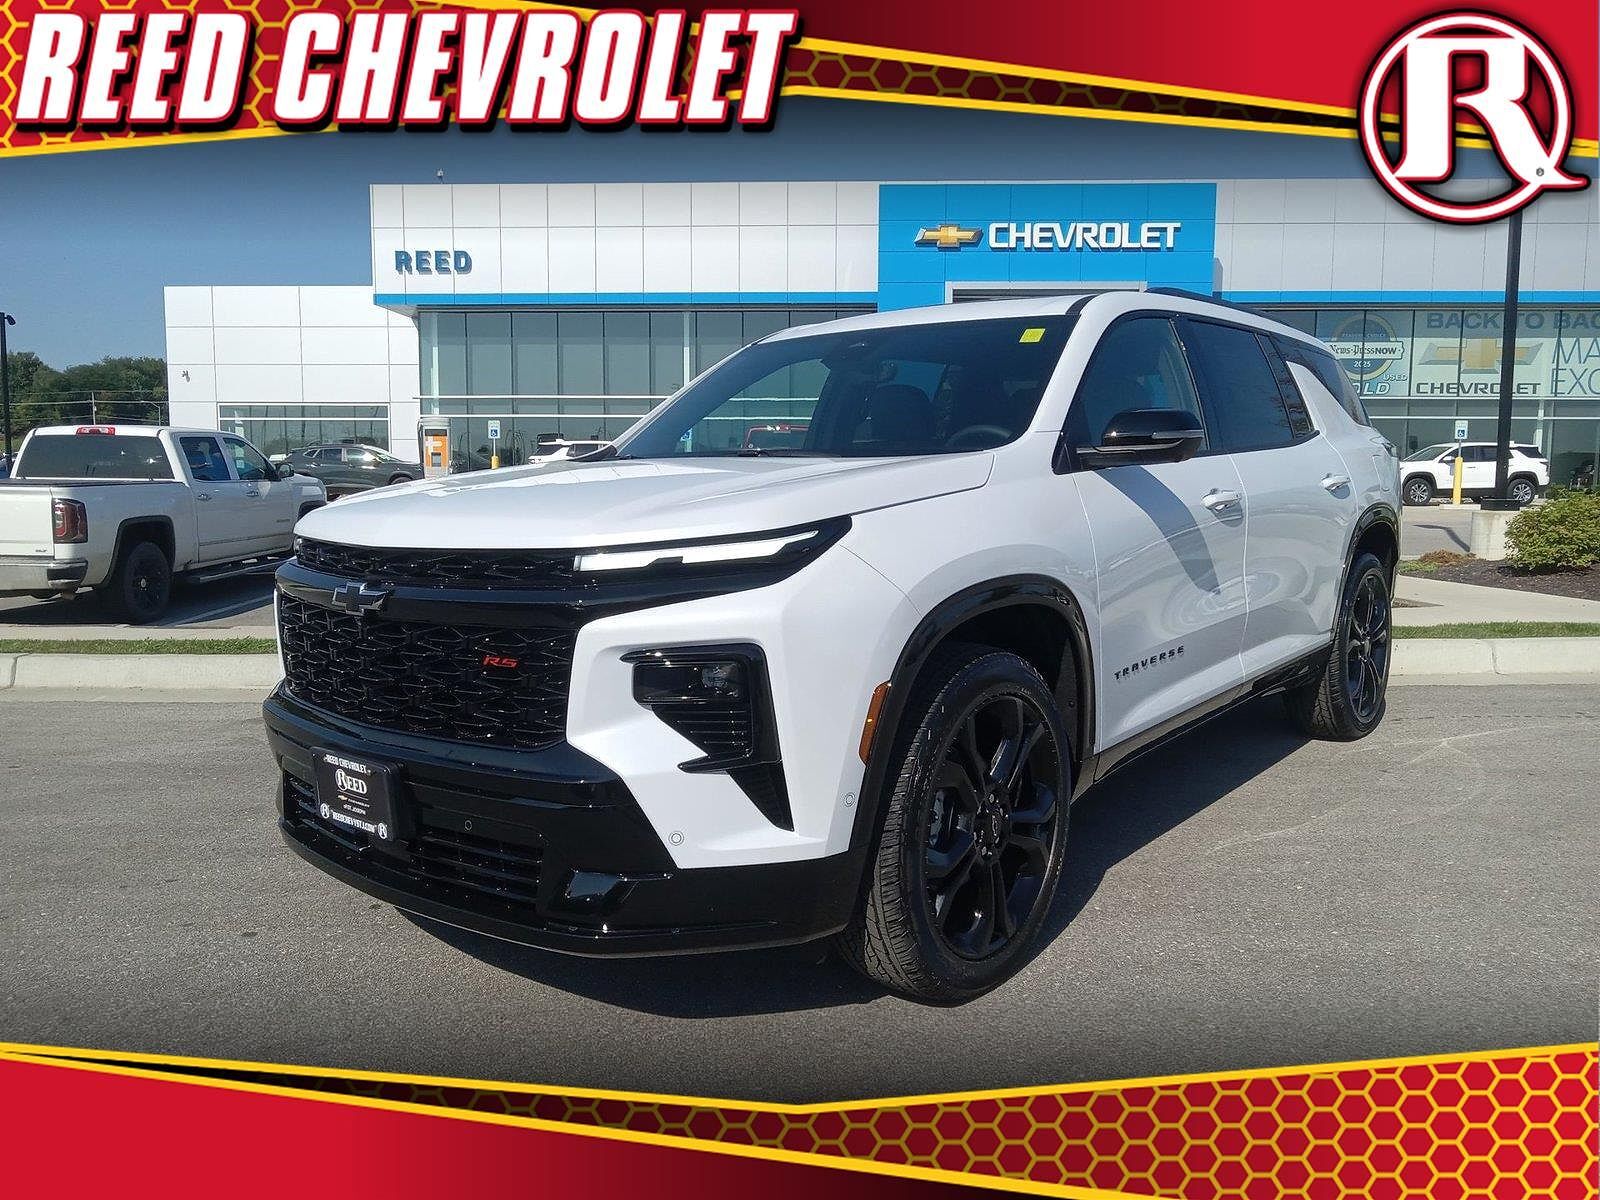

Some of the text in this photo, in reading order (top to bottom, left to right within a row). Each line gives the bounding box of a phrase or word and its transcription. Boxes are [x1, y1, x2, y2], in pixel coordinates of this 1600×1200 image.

[988, 221, 1182, 251] CHEVROLET
[394, 250, 473, 275] REED
[1427, 312, 1501, 329] BACK
[1416, 382, 1541, 395] CHEVROET
[483, 655, 519, 668] RS
[1114, 645, 1184, 680] TRAVERSE
[335, 768, 367, 794] REED
